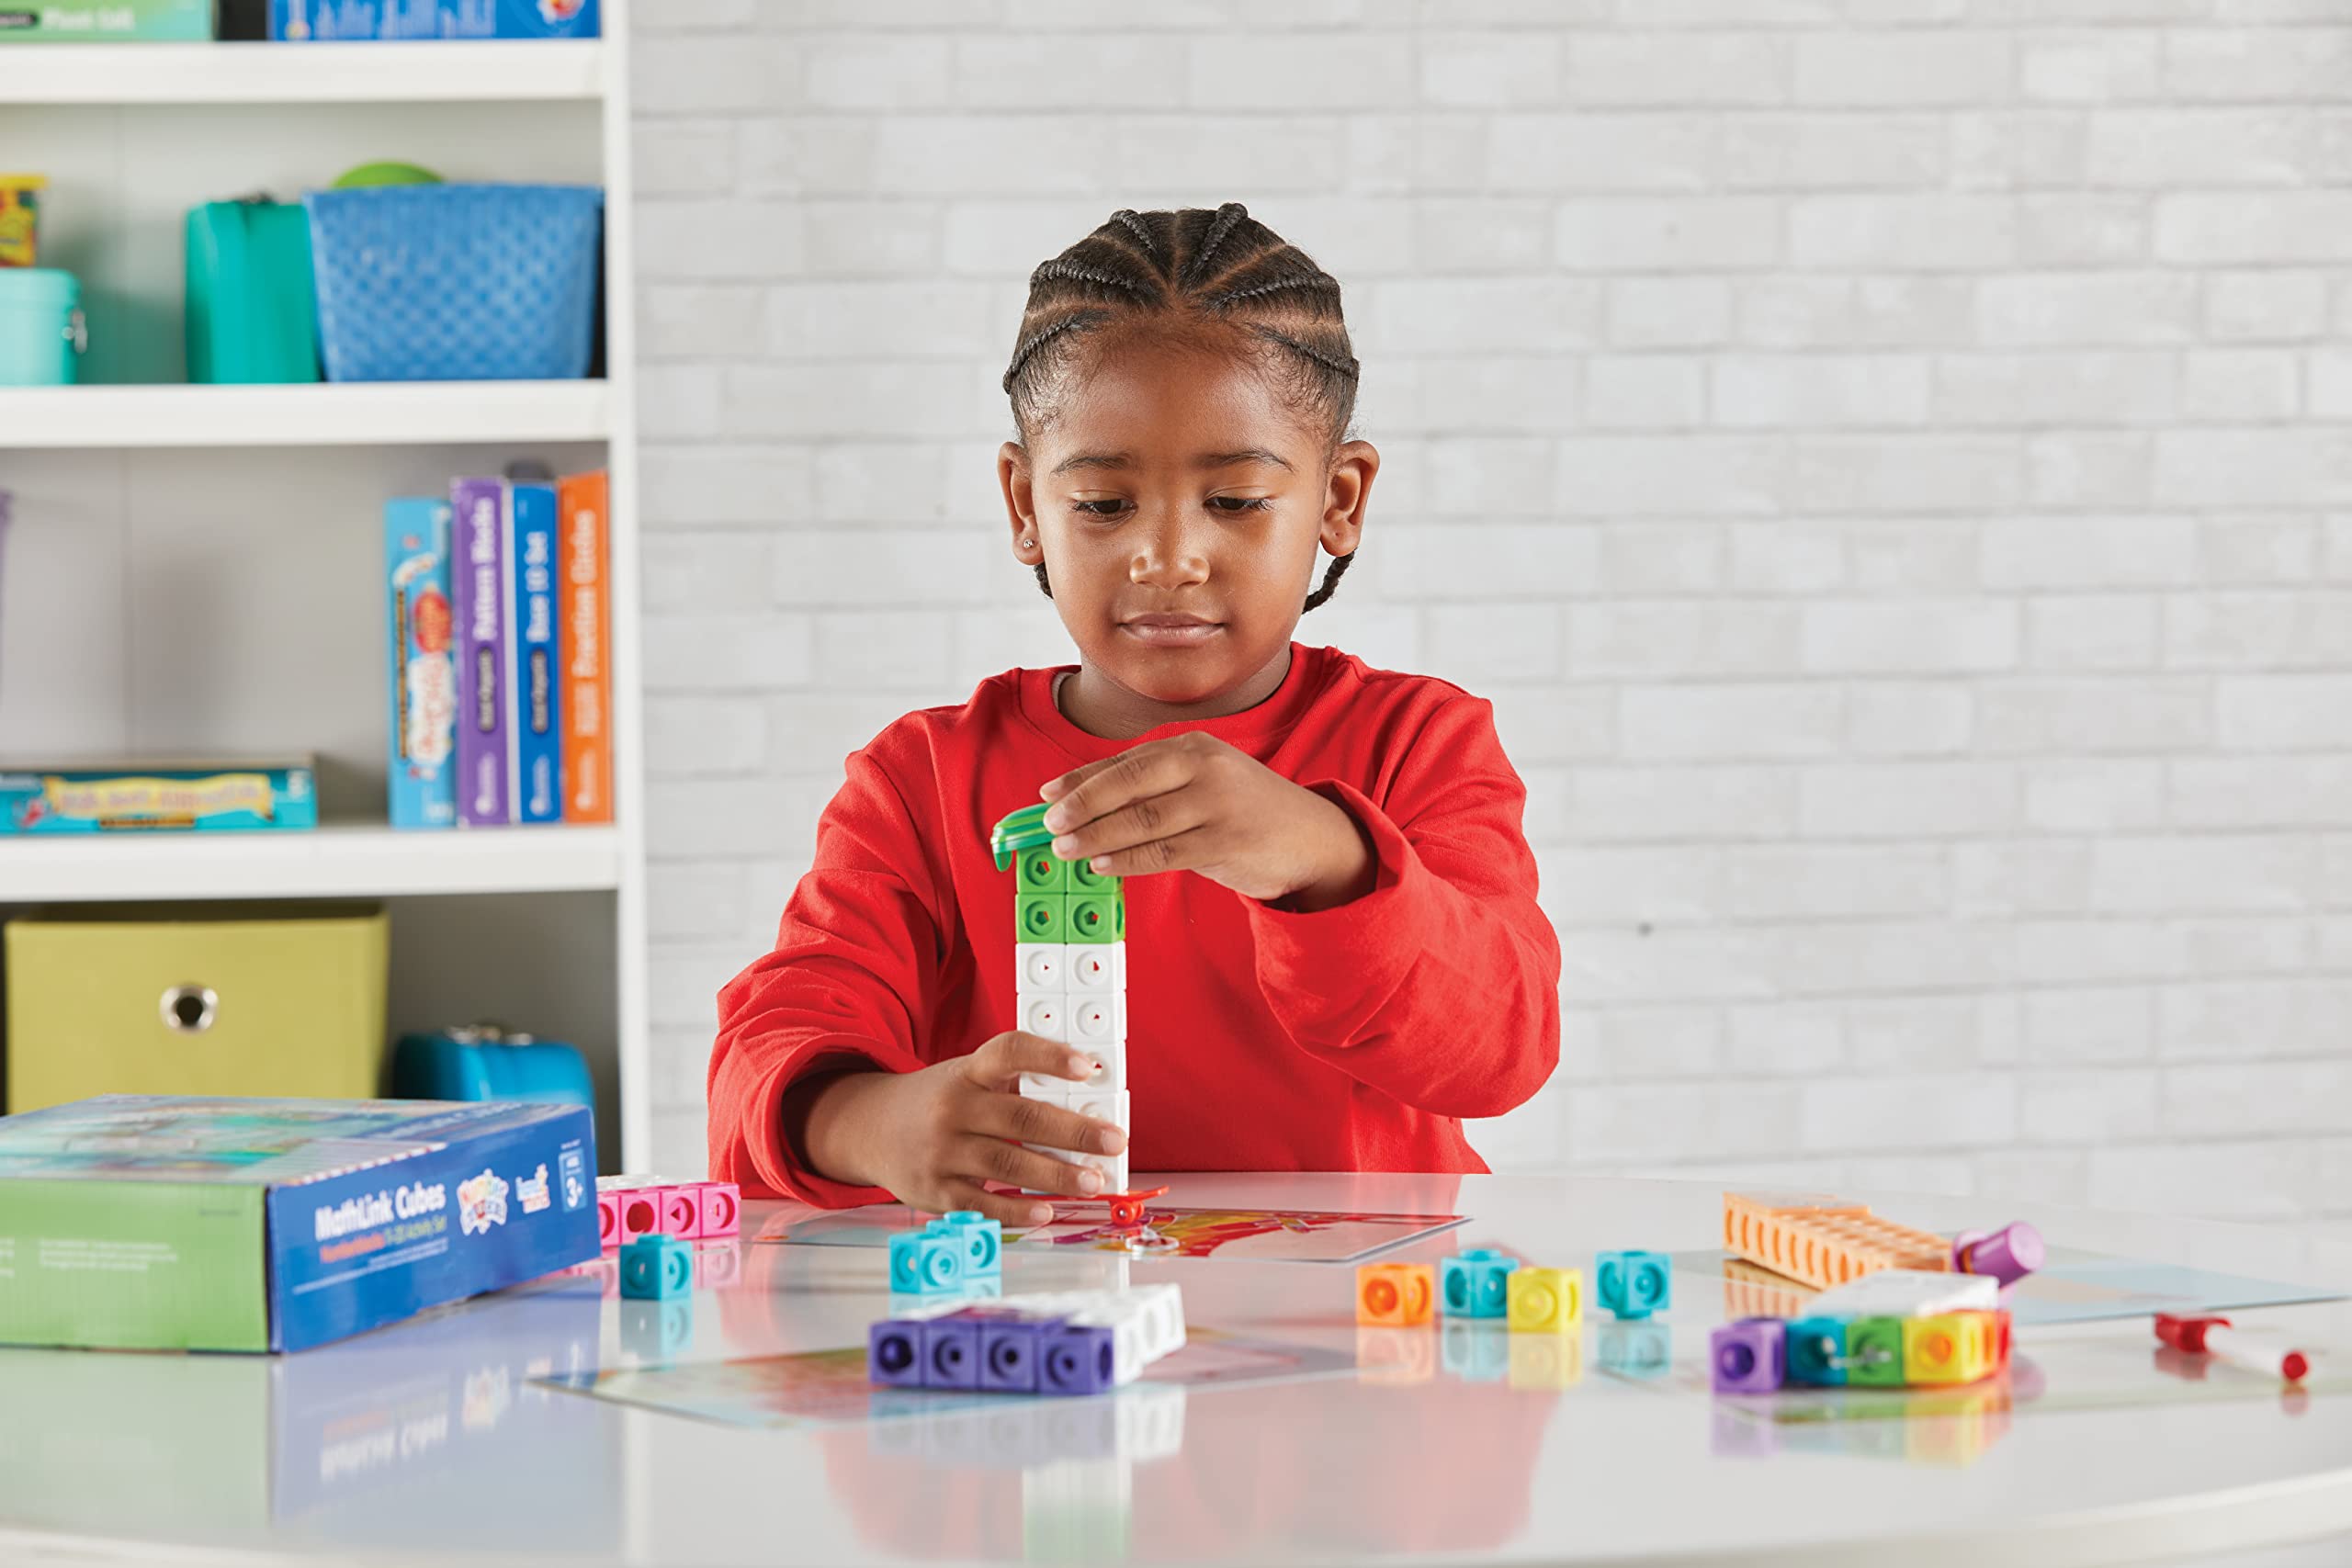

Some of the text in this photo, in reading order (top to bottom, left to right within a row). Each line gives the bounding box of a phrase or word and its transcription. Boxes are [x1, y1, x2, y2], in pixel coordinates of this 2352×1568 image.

[470, 497, 496, 564] Blocks
[525, 532, 548, 566] Set
[570, 509, 597, 584] Circles
[472, 566, 498, 641] Pattern
[526, 567, 549, 593] 10
[526, 595, 550, 643] Base
[571, 586, 598, 678] Fraction
[315, 1190, 394, 1242] MathLink
[395, 1180, 447, 1220] Cubes
[566, 1176, 583, 1208] 3+
